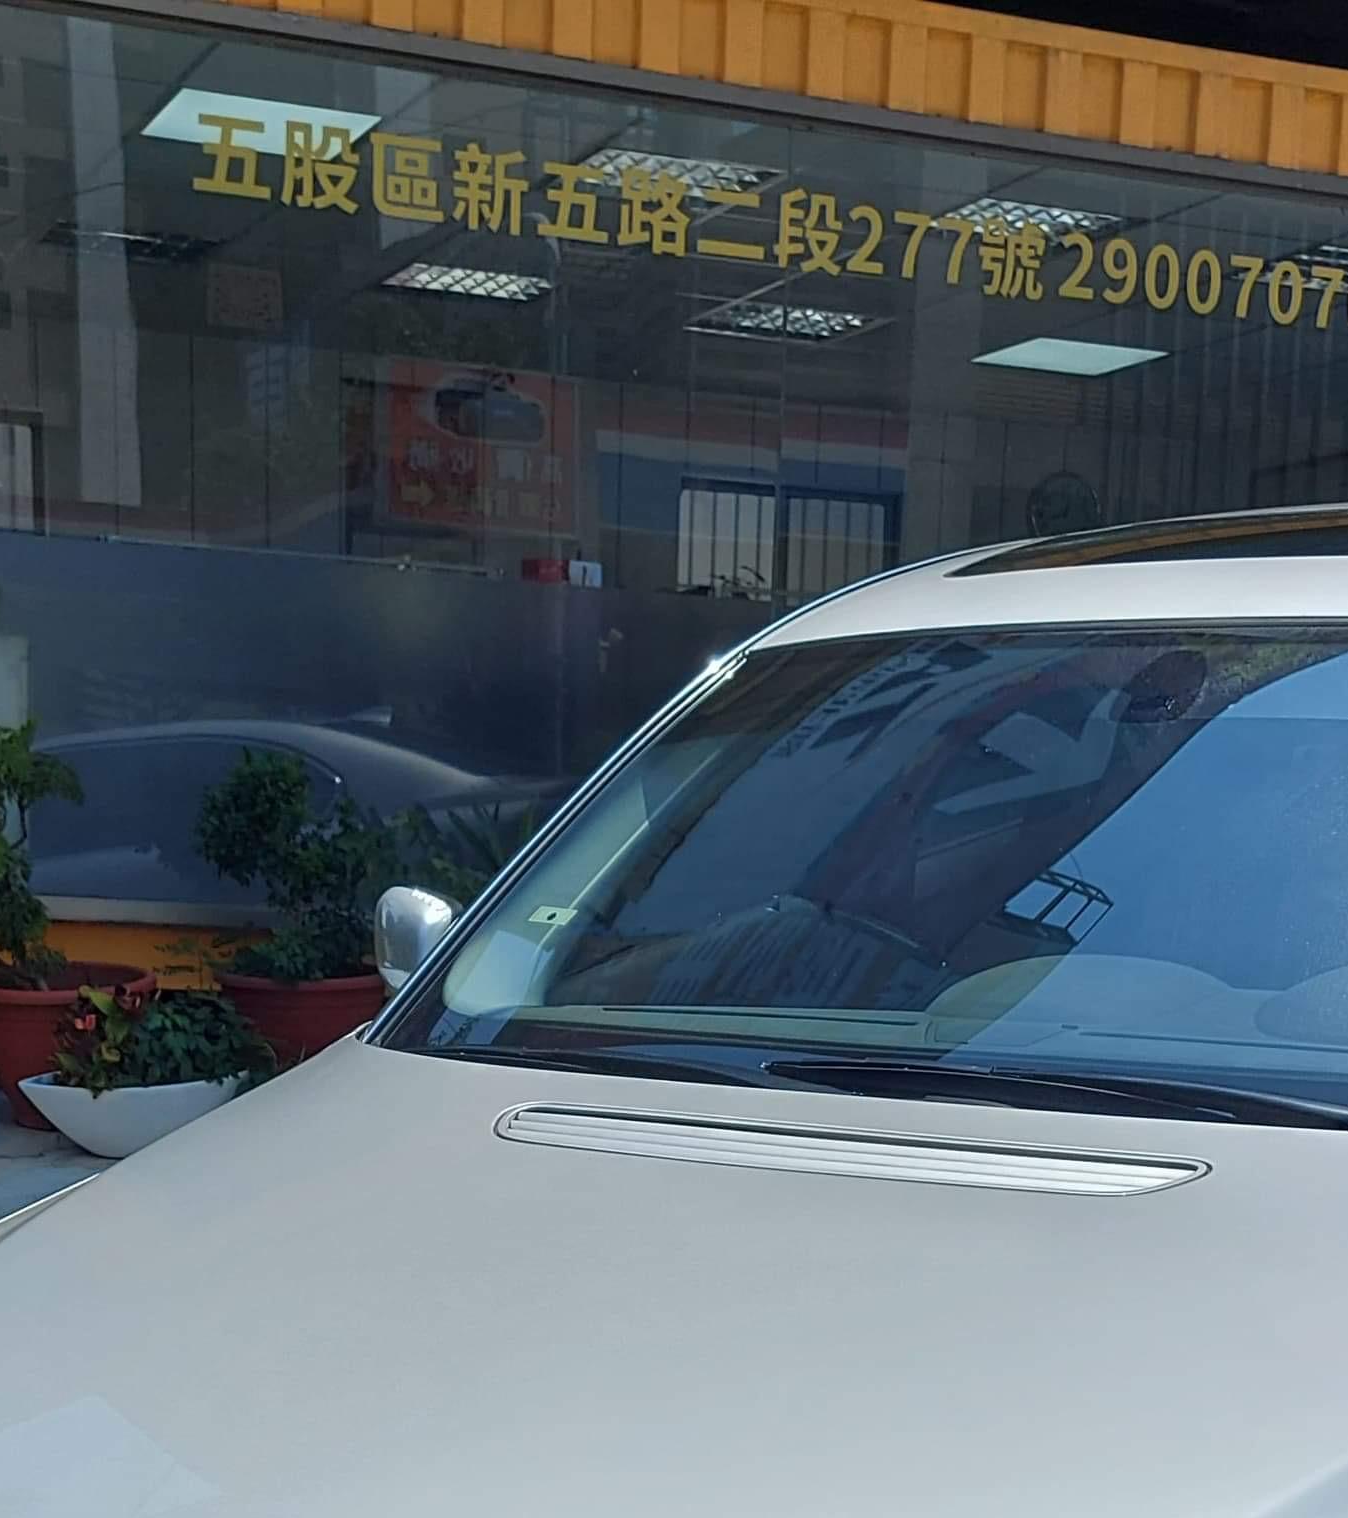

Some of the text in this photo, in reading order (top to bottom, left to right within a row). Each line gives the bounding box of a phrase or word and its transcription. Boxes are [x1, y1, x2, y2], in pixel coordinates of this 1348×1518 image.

[192, 113, 1044, 301] 五股區新五路二段277號
